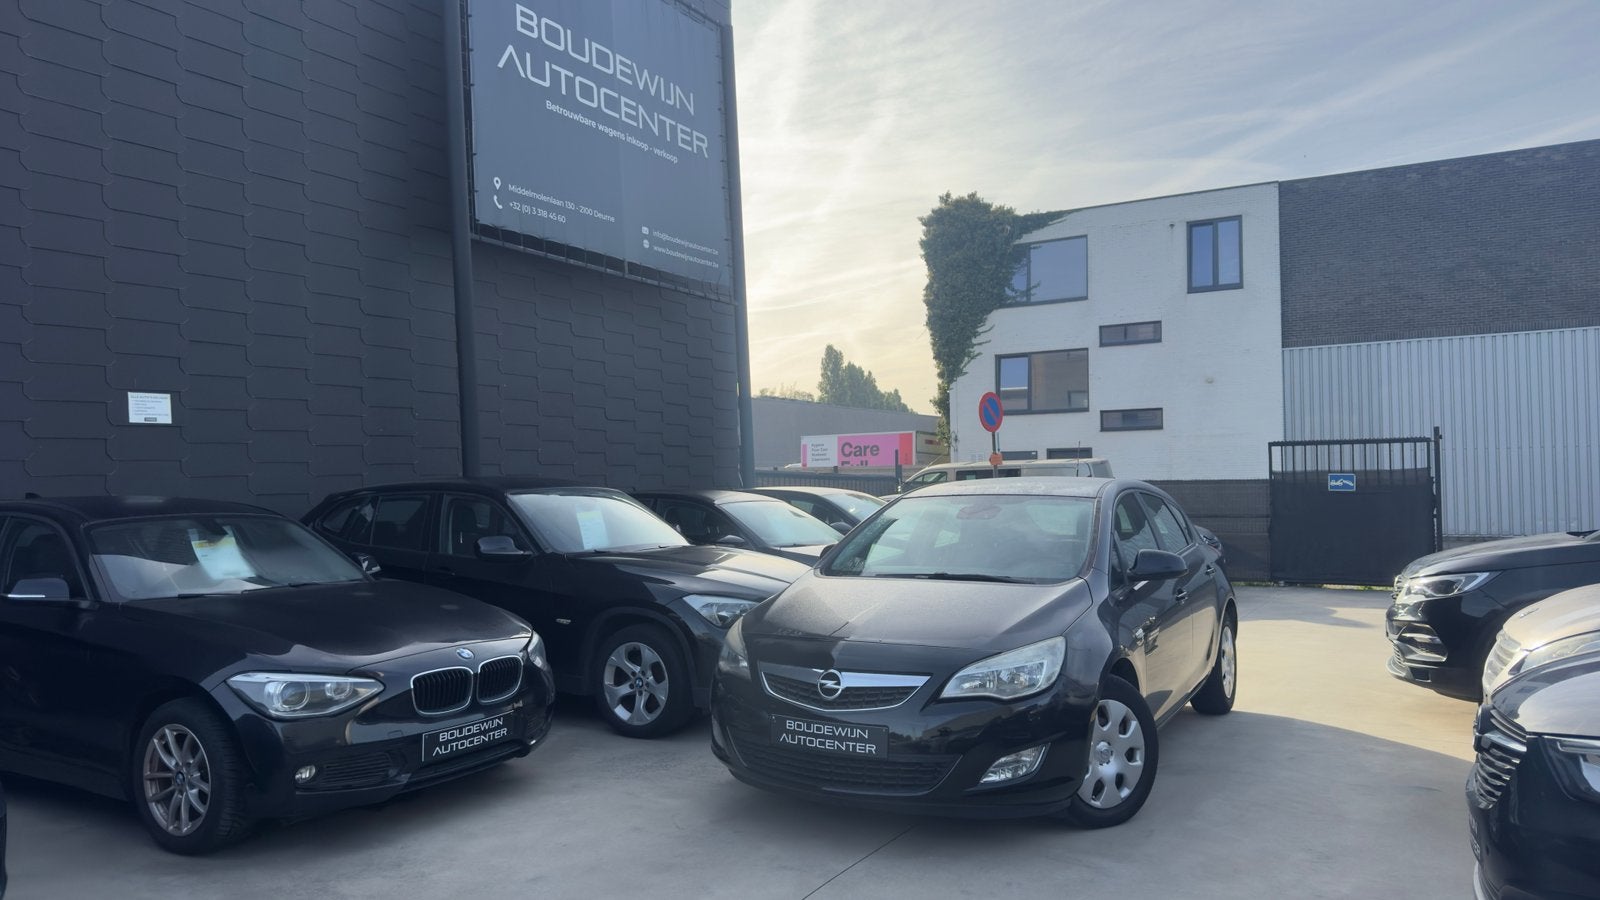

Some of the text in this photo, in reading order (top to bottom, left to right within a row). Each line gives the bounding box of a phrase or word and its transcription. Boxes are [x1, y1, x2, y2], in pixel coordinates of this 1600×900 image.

[515, 3, 695, 116] BOUDEWIJN
[497, 44, 709, 158] AUTOCENTER
[545, 100, 597, 128] Betrouwbare
[597, 123, 626, 141] wagens
[626, 133, 648, 151] inkoop
[654, 147, 678, 164] verkoop
[508, 184, 564, 207] Middelmolenlaan
[565, 201, 575, 210] 130
[579, 205, 593, 216] 2100
[593, 209, 616, 223] Deurne
[509, 201, 566, 223] +32 (0) 3 318 45 60
[840, 442, 880, 457] Care
[432, 727, 508, 757] AUTOCENTER
[439, 716, 504, 742] BOUDEWIJN
[786, 719, 869, 739] BOUDEWIJN
[779, 733, 876, 755] AUTOCENTER
